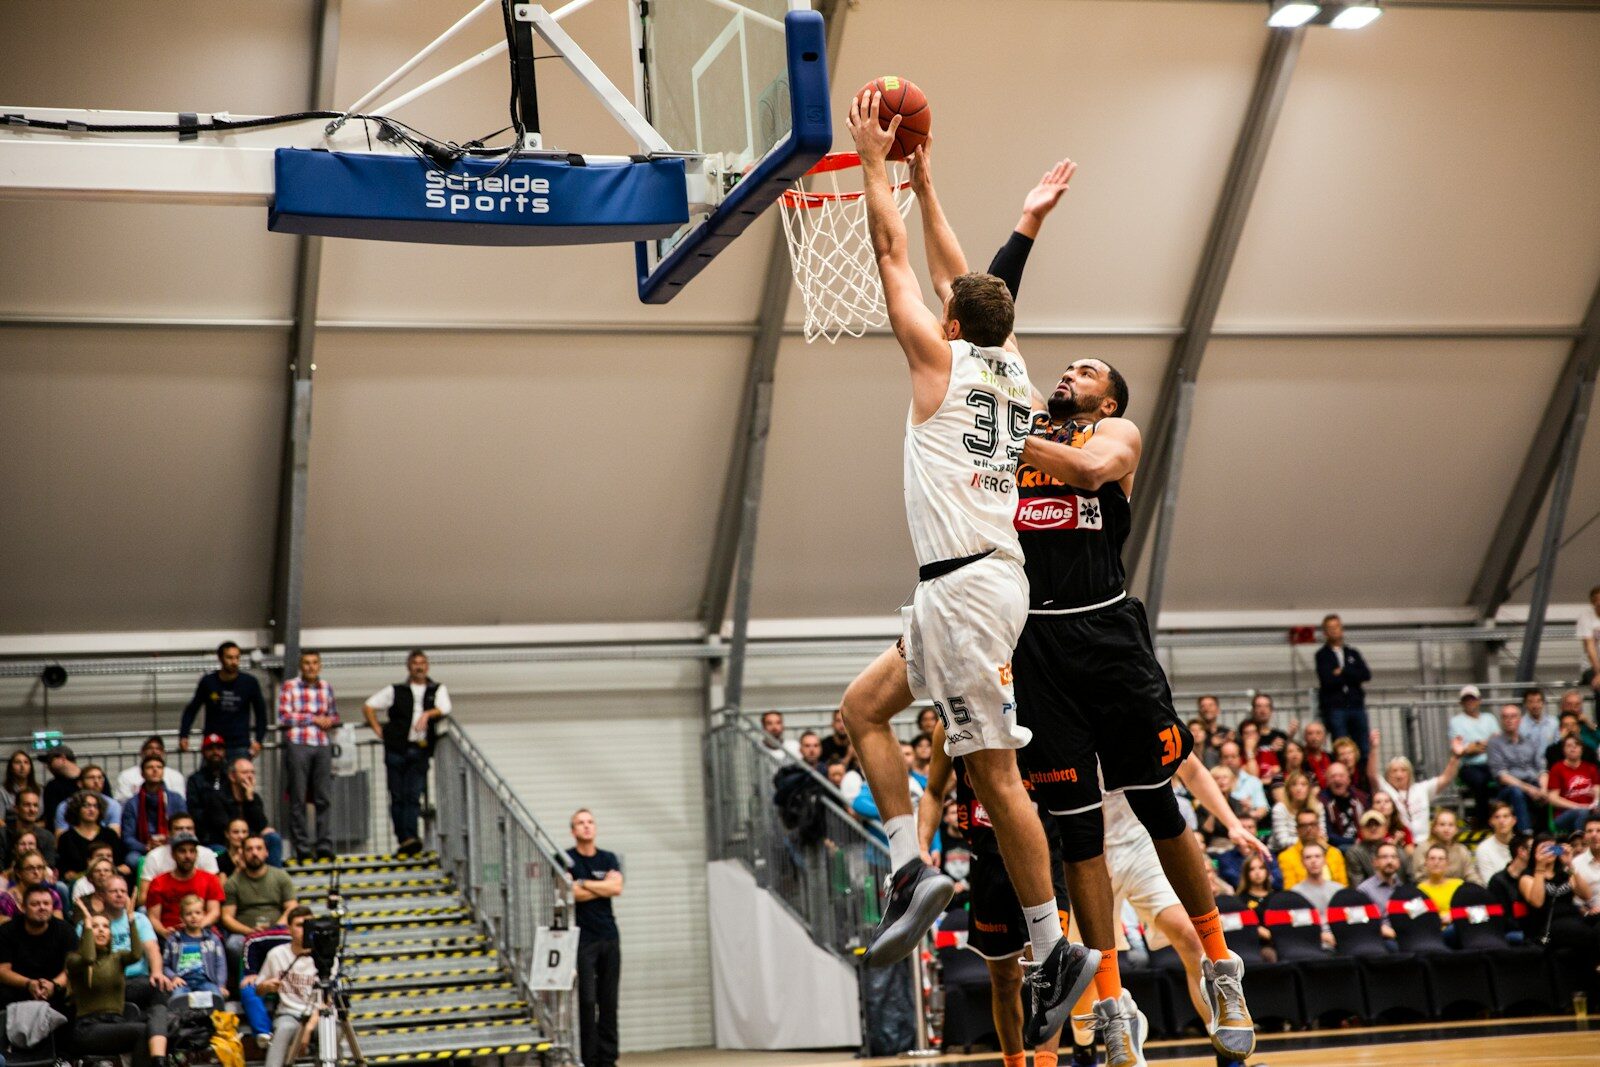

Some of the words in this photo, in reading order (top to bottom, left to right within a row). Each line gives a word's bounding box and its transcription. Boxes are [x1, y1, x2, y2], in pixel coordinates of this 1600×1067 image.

[425, 170, 549, 194] Schelde
[425, 189, 549, 214] Sports
[962, 388, 1032, 460] 35
[1018, 505, 1073, 521] Helios
[1158, 724, 1183, 766] 31
[548, 950, 560, 968] D
